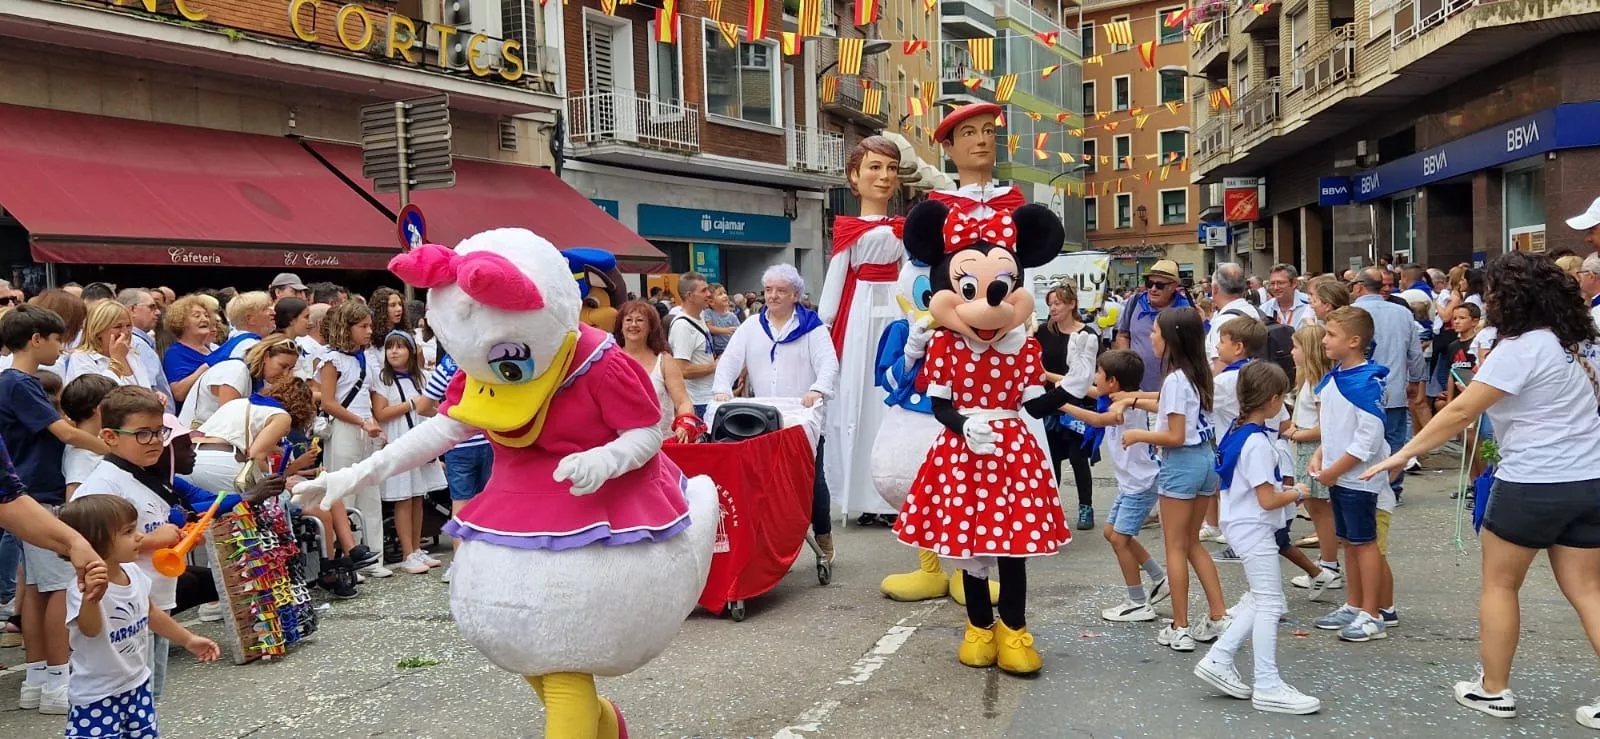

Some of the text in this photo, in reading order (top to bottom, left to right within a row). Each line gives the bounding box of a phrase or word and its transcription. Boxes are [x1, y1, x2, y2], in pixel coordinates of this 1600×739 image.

[289, 0, 524, 81] CORTES
[1507, 119, 1540, 152] BBVA
[1423, 149, 1448, 176] BBVA
[1322, 186, 1348, 195] BBVA
[1361, 172, 1380, 194] BBVA
[713, 216, 745, 234] cajamar
[284, 251, 299, 266] El
